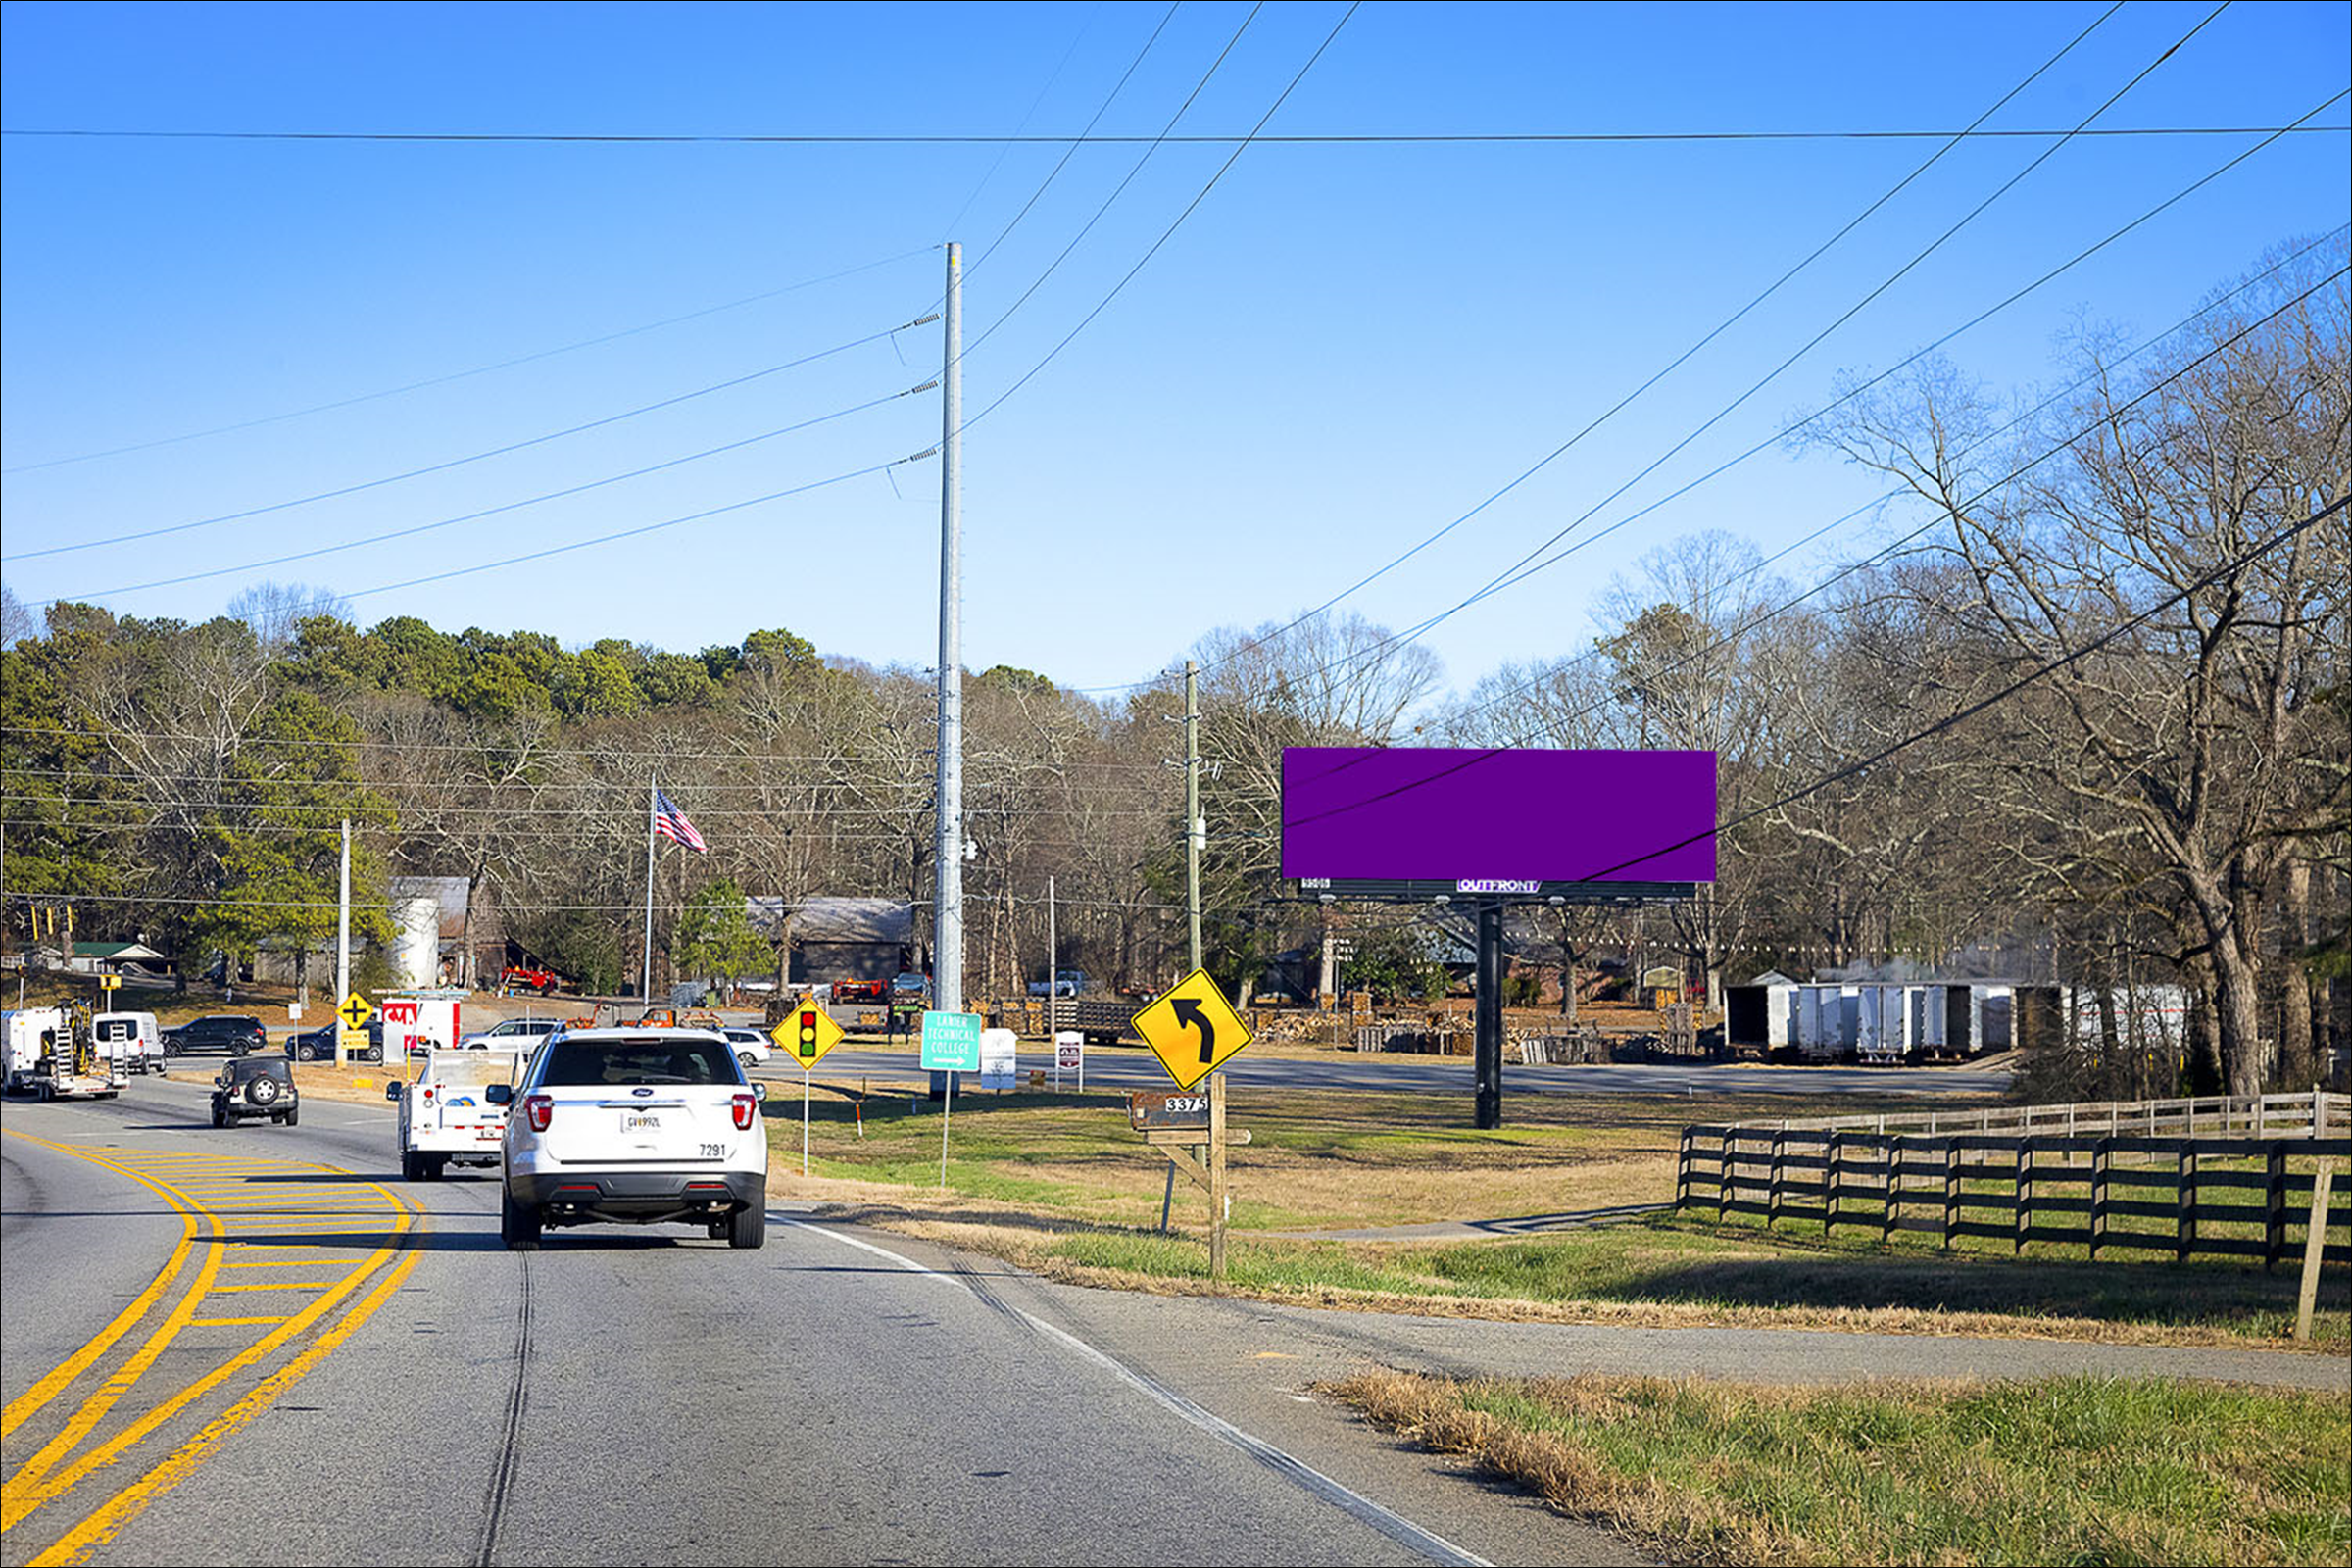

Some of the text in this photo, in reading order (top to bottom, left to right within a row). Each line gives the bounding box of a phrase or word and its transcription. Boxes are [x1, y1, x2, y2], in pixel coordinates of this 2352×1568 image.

[1459, 879, 1539, 892] OUTFRONT
[937, 1015, 968, 1028] LANIER
[928, 1028, 976, 1042] TECHNICAL
[931, 1041, 970, 1054] COLLEGE
[1167, 1098, 1206, 1111] 3375
[699, 1143, 725, 1157] 7291
